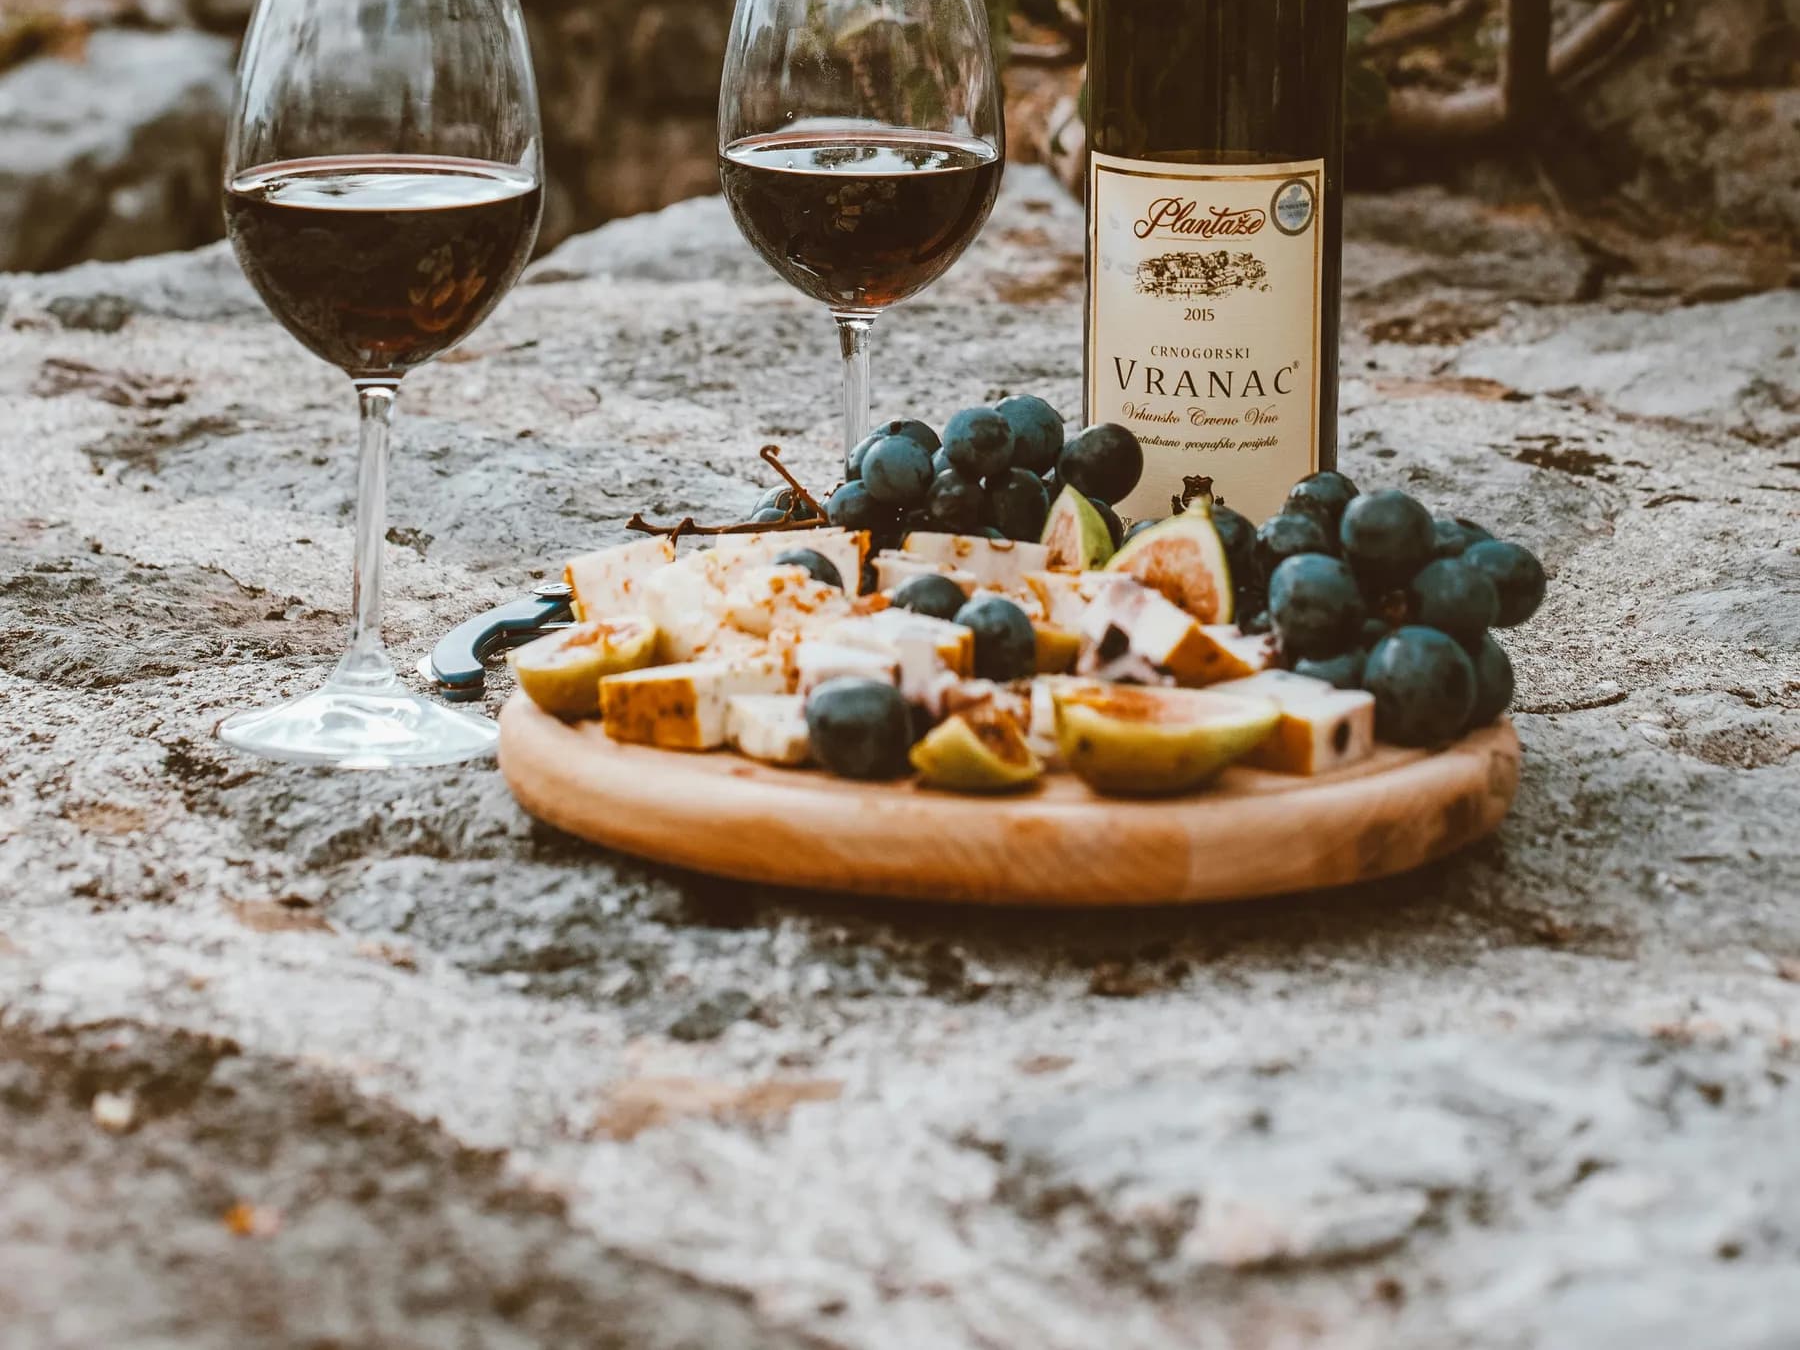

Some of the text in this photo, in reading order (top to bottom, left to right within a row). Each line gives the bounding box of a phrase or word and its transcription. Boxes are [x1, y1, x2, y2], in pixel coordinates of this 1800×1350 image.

[1133, 197, 1266, 238] Plantaže
[1183, 307, 1216, 322] 2015
[1150, 345, 1250, 359] CRNOGORSKI
[1121, 401, 1279, 427] Vrhunsko Crveno Vino
[1132, 431, 1181, 448] ntrolisano
